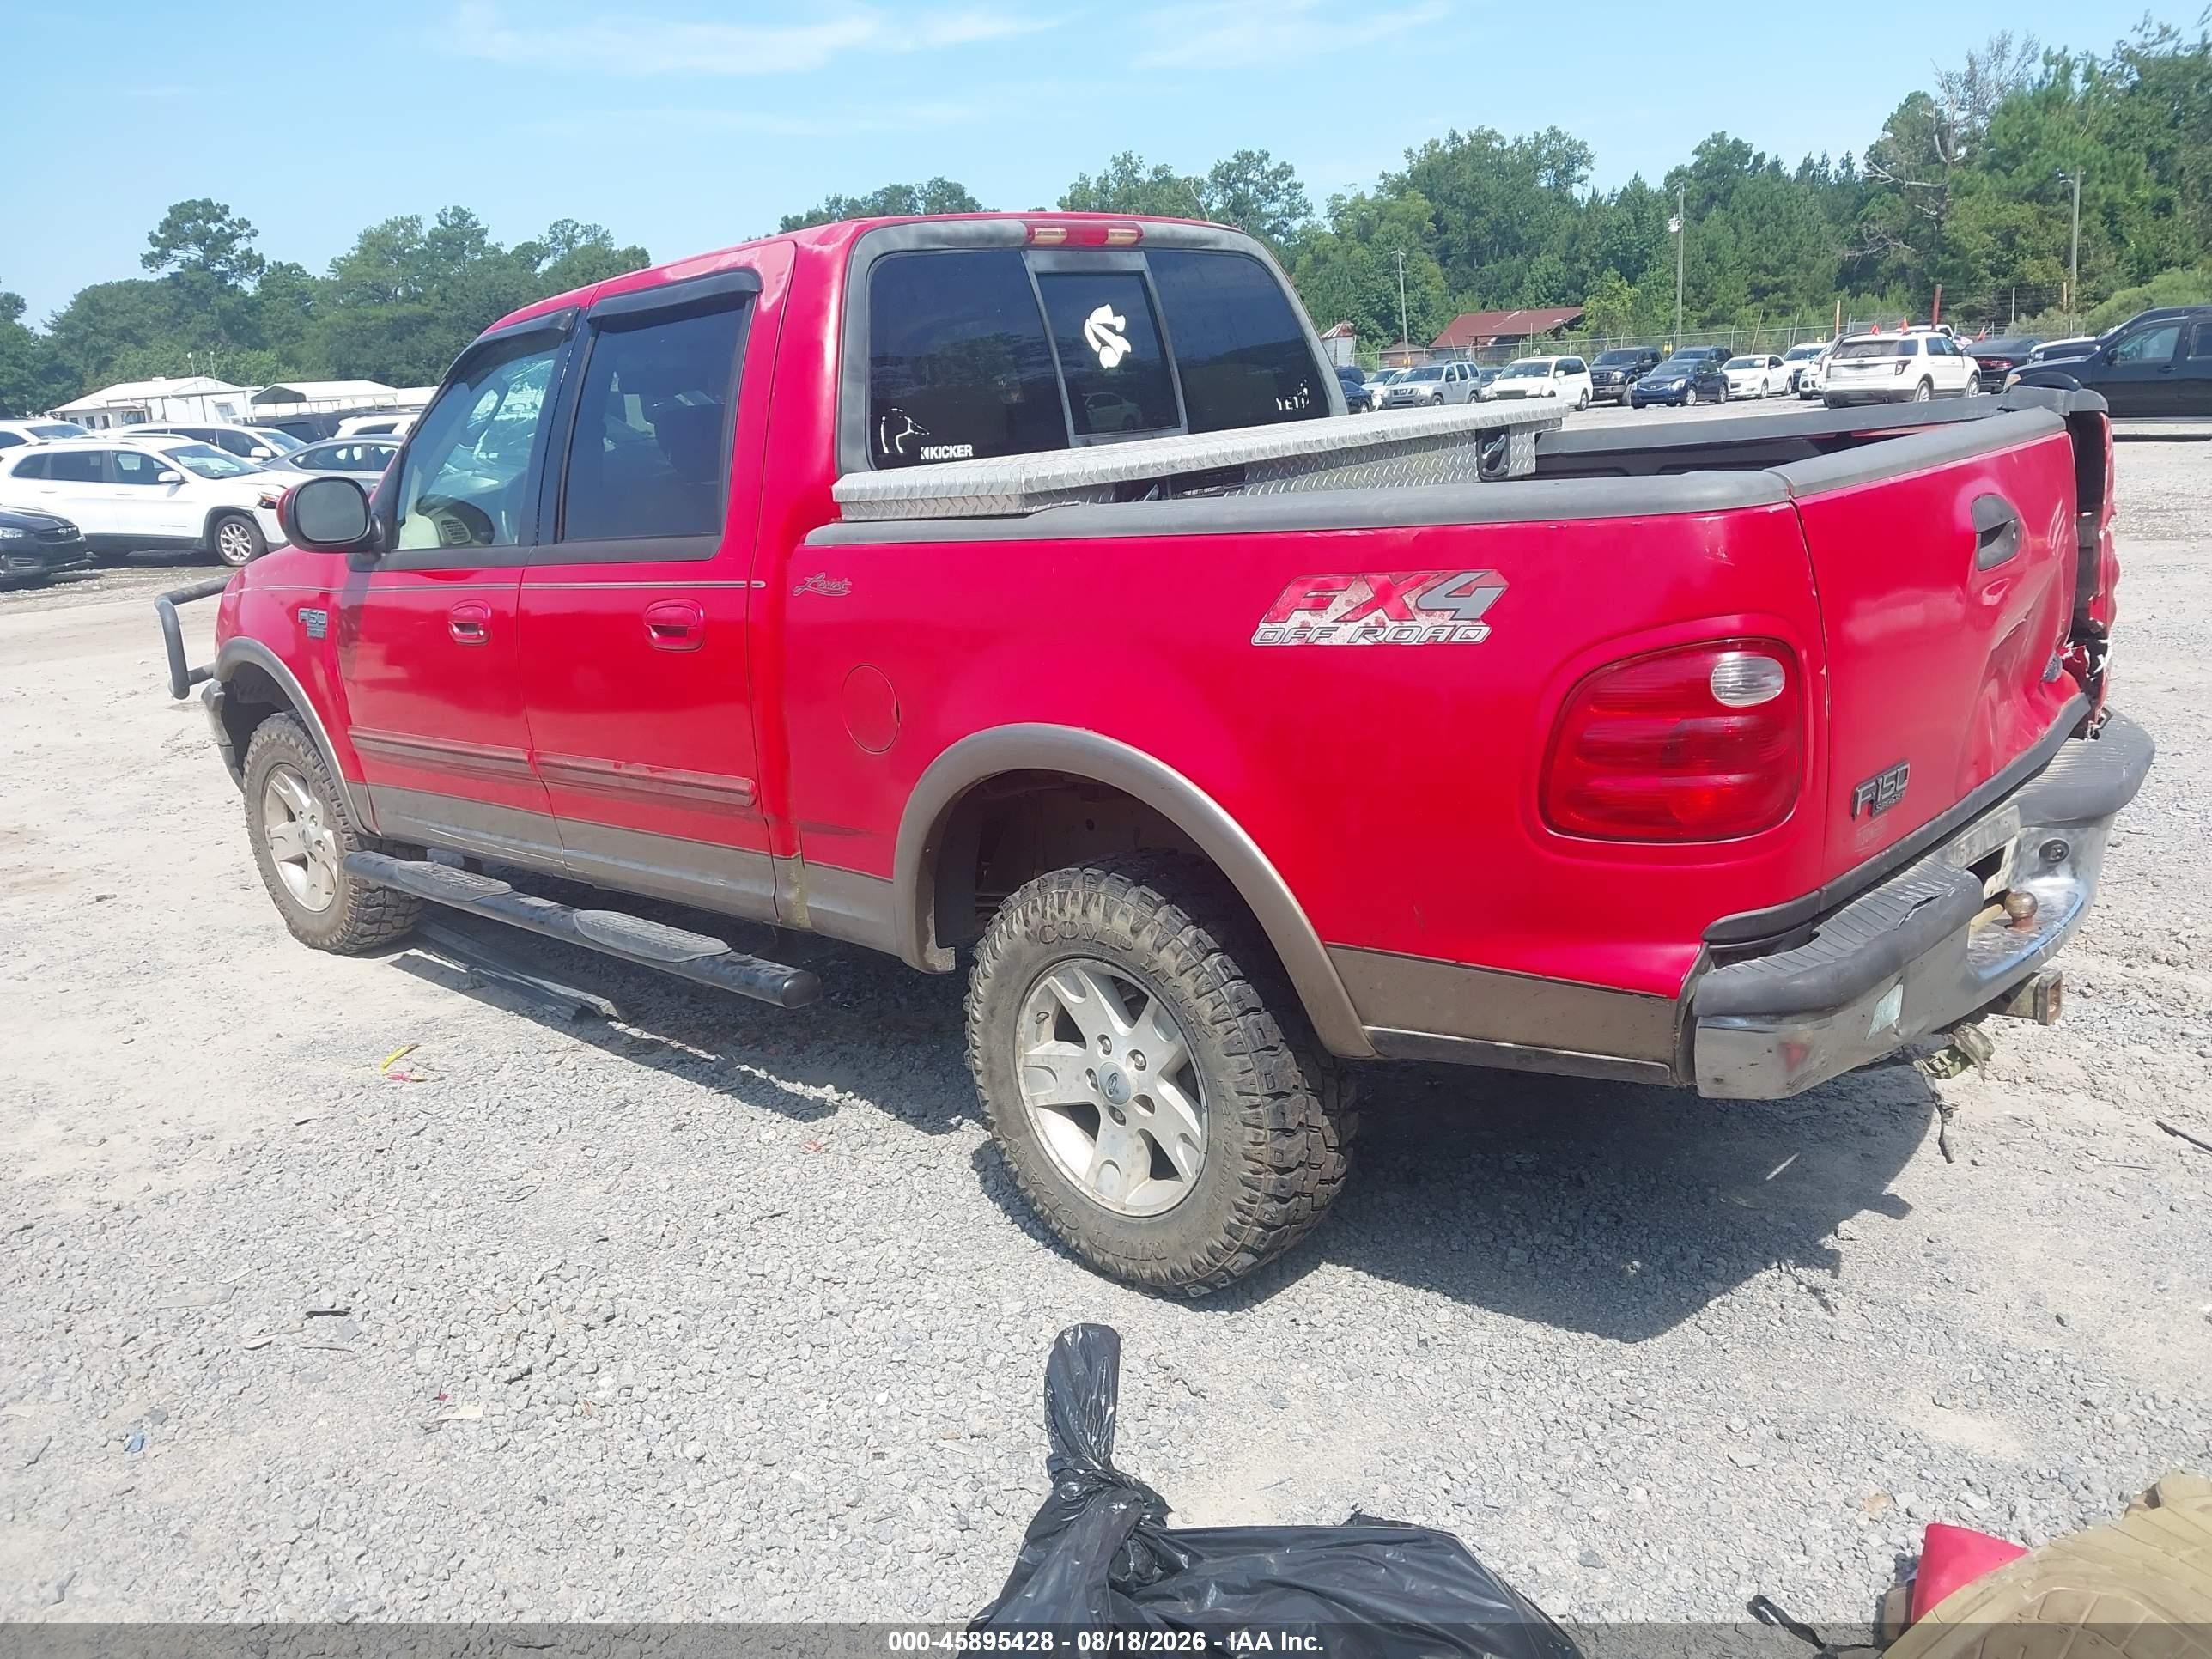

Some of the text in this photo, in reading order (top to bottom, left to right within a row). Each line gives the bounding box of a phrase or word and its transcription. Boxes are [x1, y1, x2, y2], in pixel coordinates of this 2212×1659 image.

[930, 444, 974, 459] KICKER
[1263, 570, 1508, 623] FX4
[1253, 625, 1492, 645] OFF ROAD
[1854, 763, 1911, 816] F150
